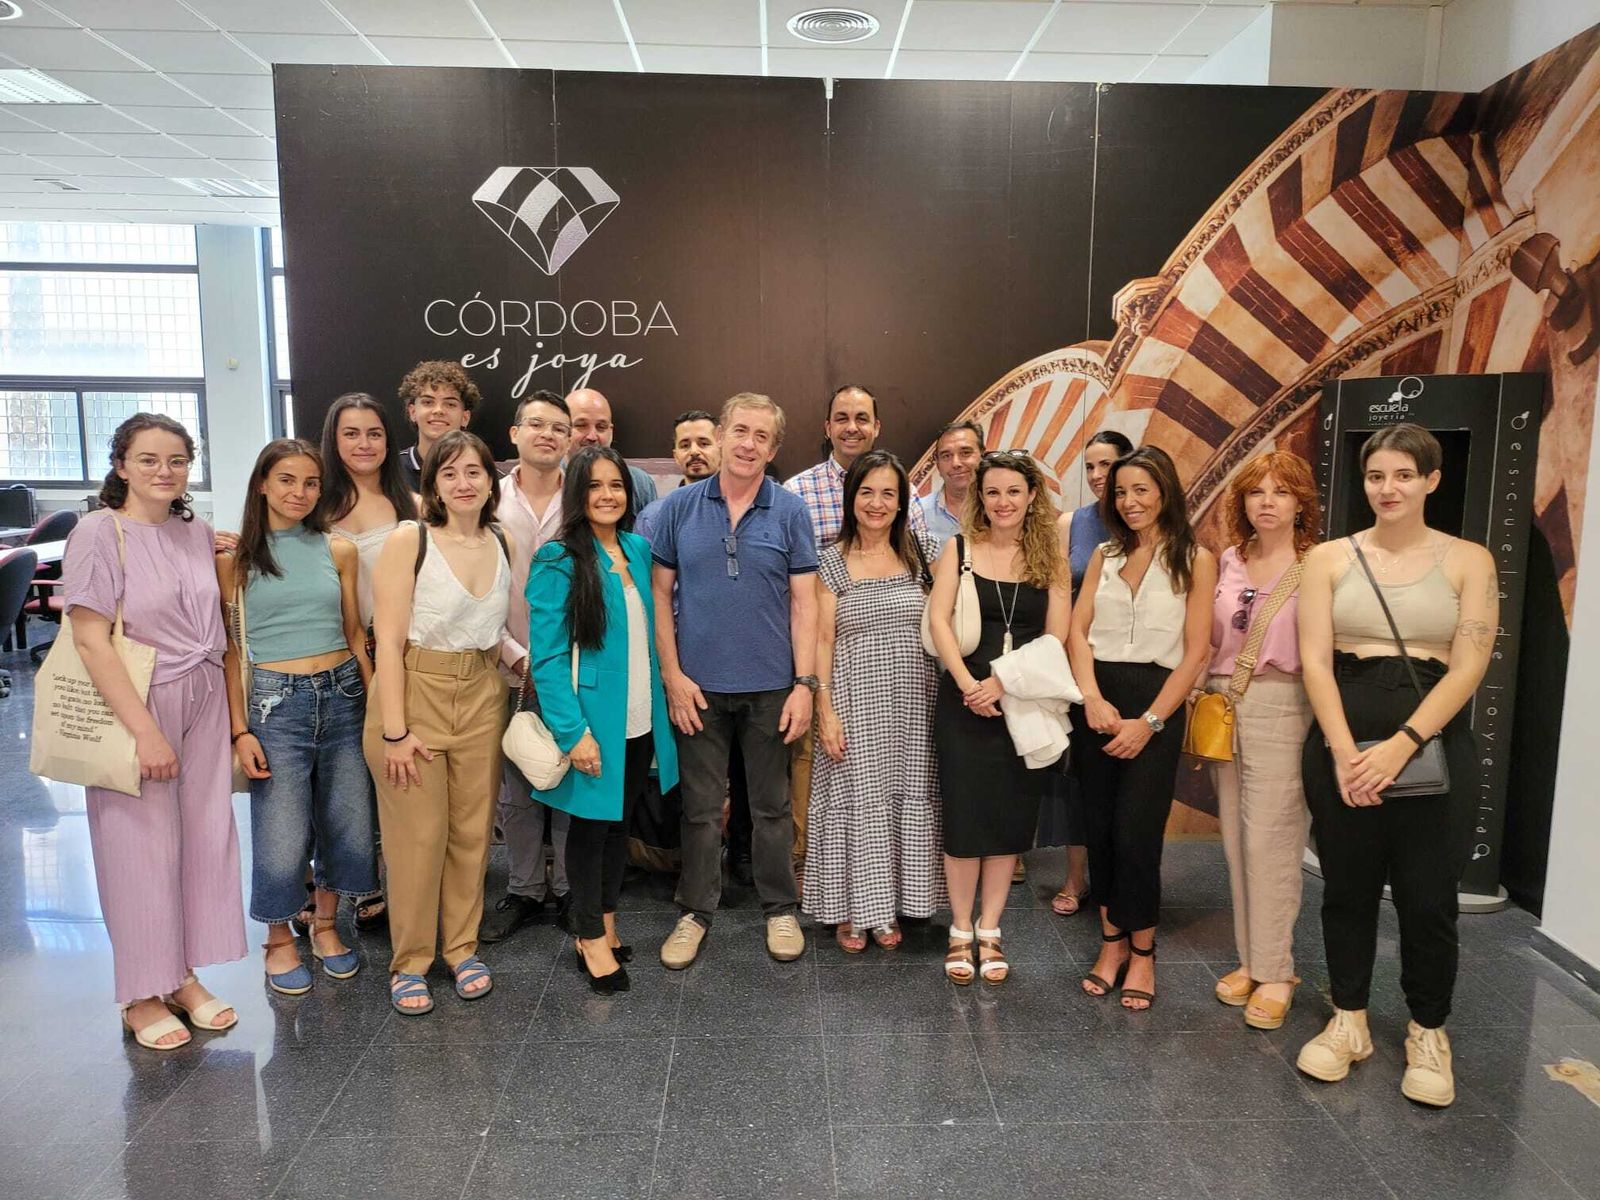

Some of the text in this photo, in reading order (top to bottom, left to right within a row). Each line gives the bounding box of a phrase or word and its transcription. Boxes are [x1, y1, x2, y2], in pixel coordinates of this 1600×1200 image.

[424, 291, 679, 337] CÓRDOBA
[460, 341, 644, 400] es joya
[1368, 400, 1409, 413] escuela
